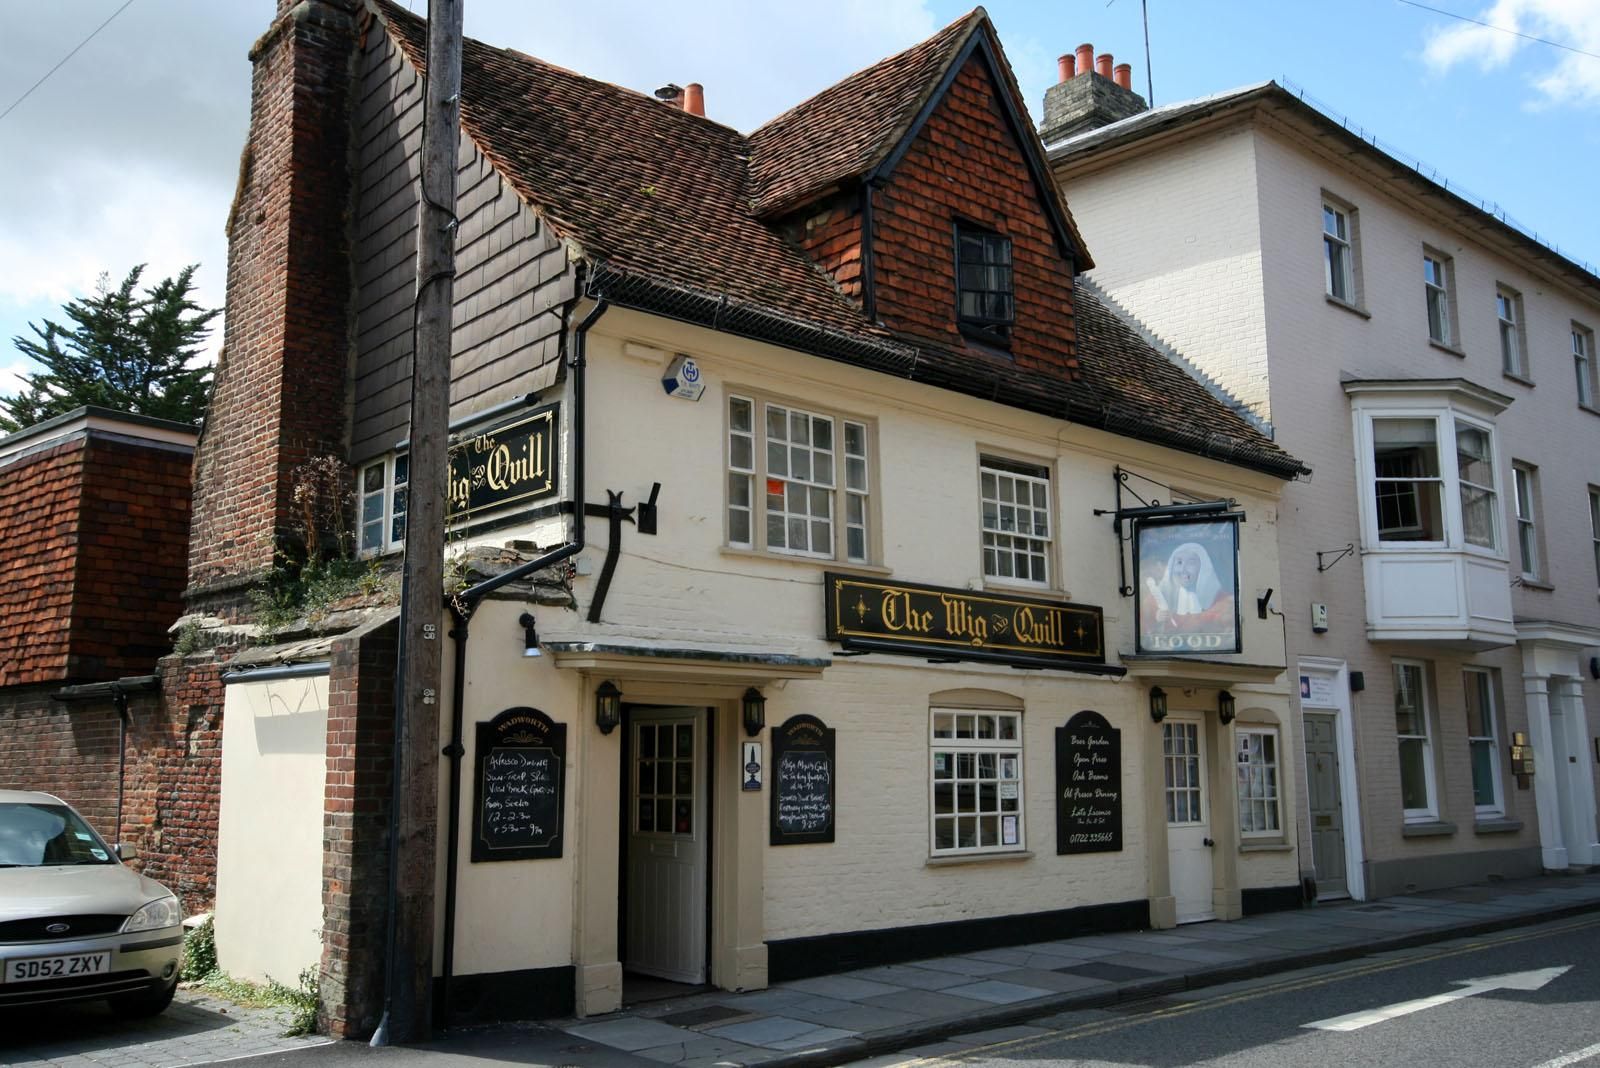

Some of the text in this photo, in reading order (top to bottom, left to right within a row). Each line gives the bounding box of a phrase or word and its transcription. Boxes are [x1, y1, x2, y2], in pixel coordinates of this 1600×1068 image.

[475, 434, 495, 453] The
[487, 432, 545, 490] Quill
[881, 589, 1065, 647] The Wig AND Quill
[1152, 635, 1222, 648] FOOD
[498, 716, 550, 733] WADWORTH
[1071, 735, 1110, 750] Beer Garden
[1073, 752, 1108, 767] Open Fires
[1072, 769, 1109, 781] Oak Beams
[1064, 787, 1117, 802] Al Fresco Dining
[1071, 805, 1087, 816] Late
[1070, 833, 1088, 843] 01722
[15, 955, 104, 979] SD52 ZXY
